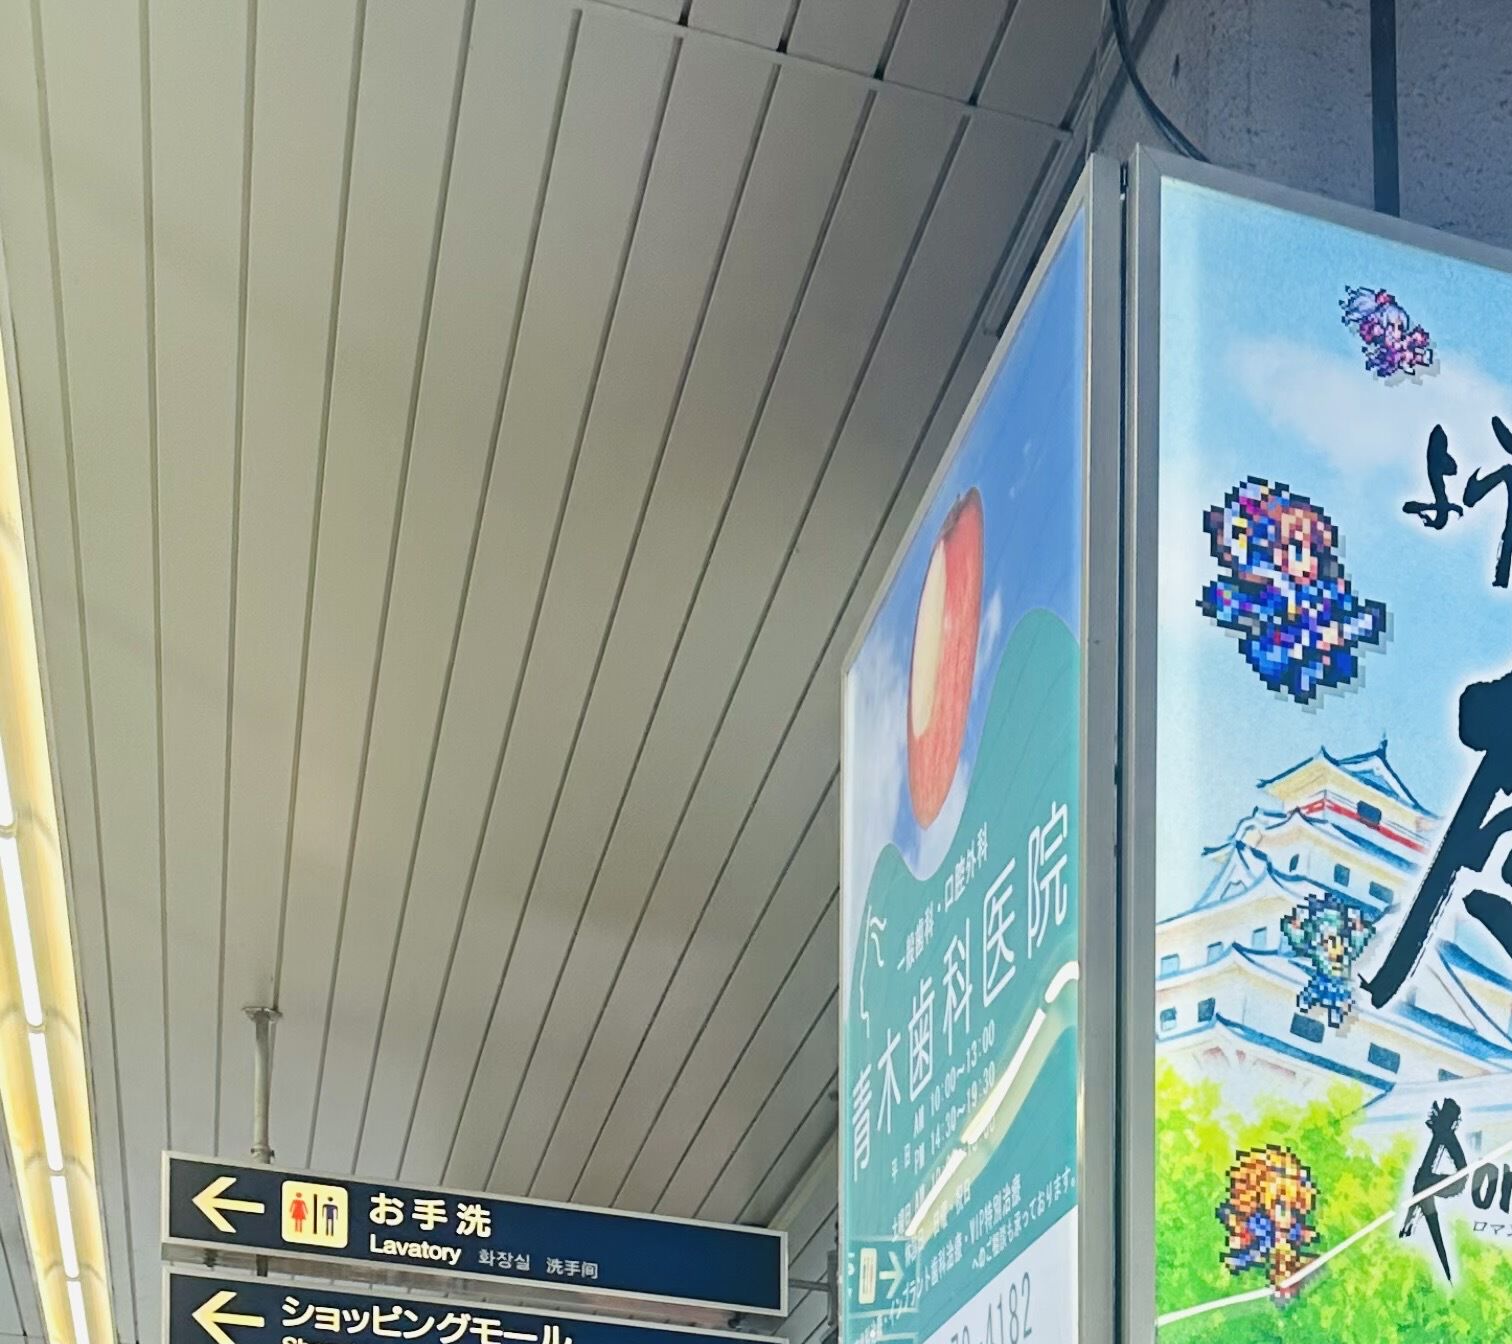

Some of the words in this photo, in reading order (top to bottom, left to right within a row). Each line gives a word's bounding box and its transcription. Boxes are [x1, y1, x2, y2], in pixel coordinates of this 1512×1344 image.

[897, 821, 988, 973] 一般歯科・口腔外科
[852, 803, 1069, 1183] 青木歯科医院
[369, 1192, 492, 1239] お手洗
[369, 1234, 461, 1266] Lavatory
[478, 1248, 531, 1272] 화장실
[545, 1257, 599, 1280] 洗手间
